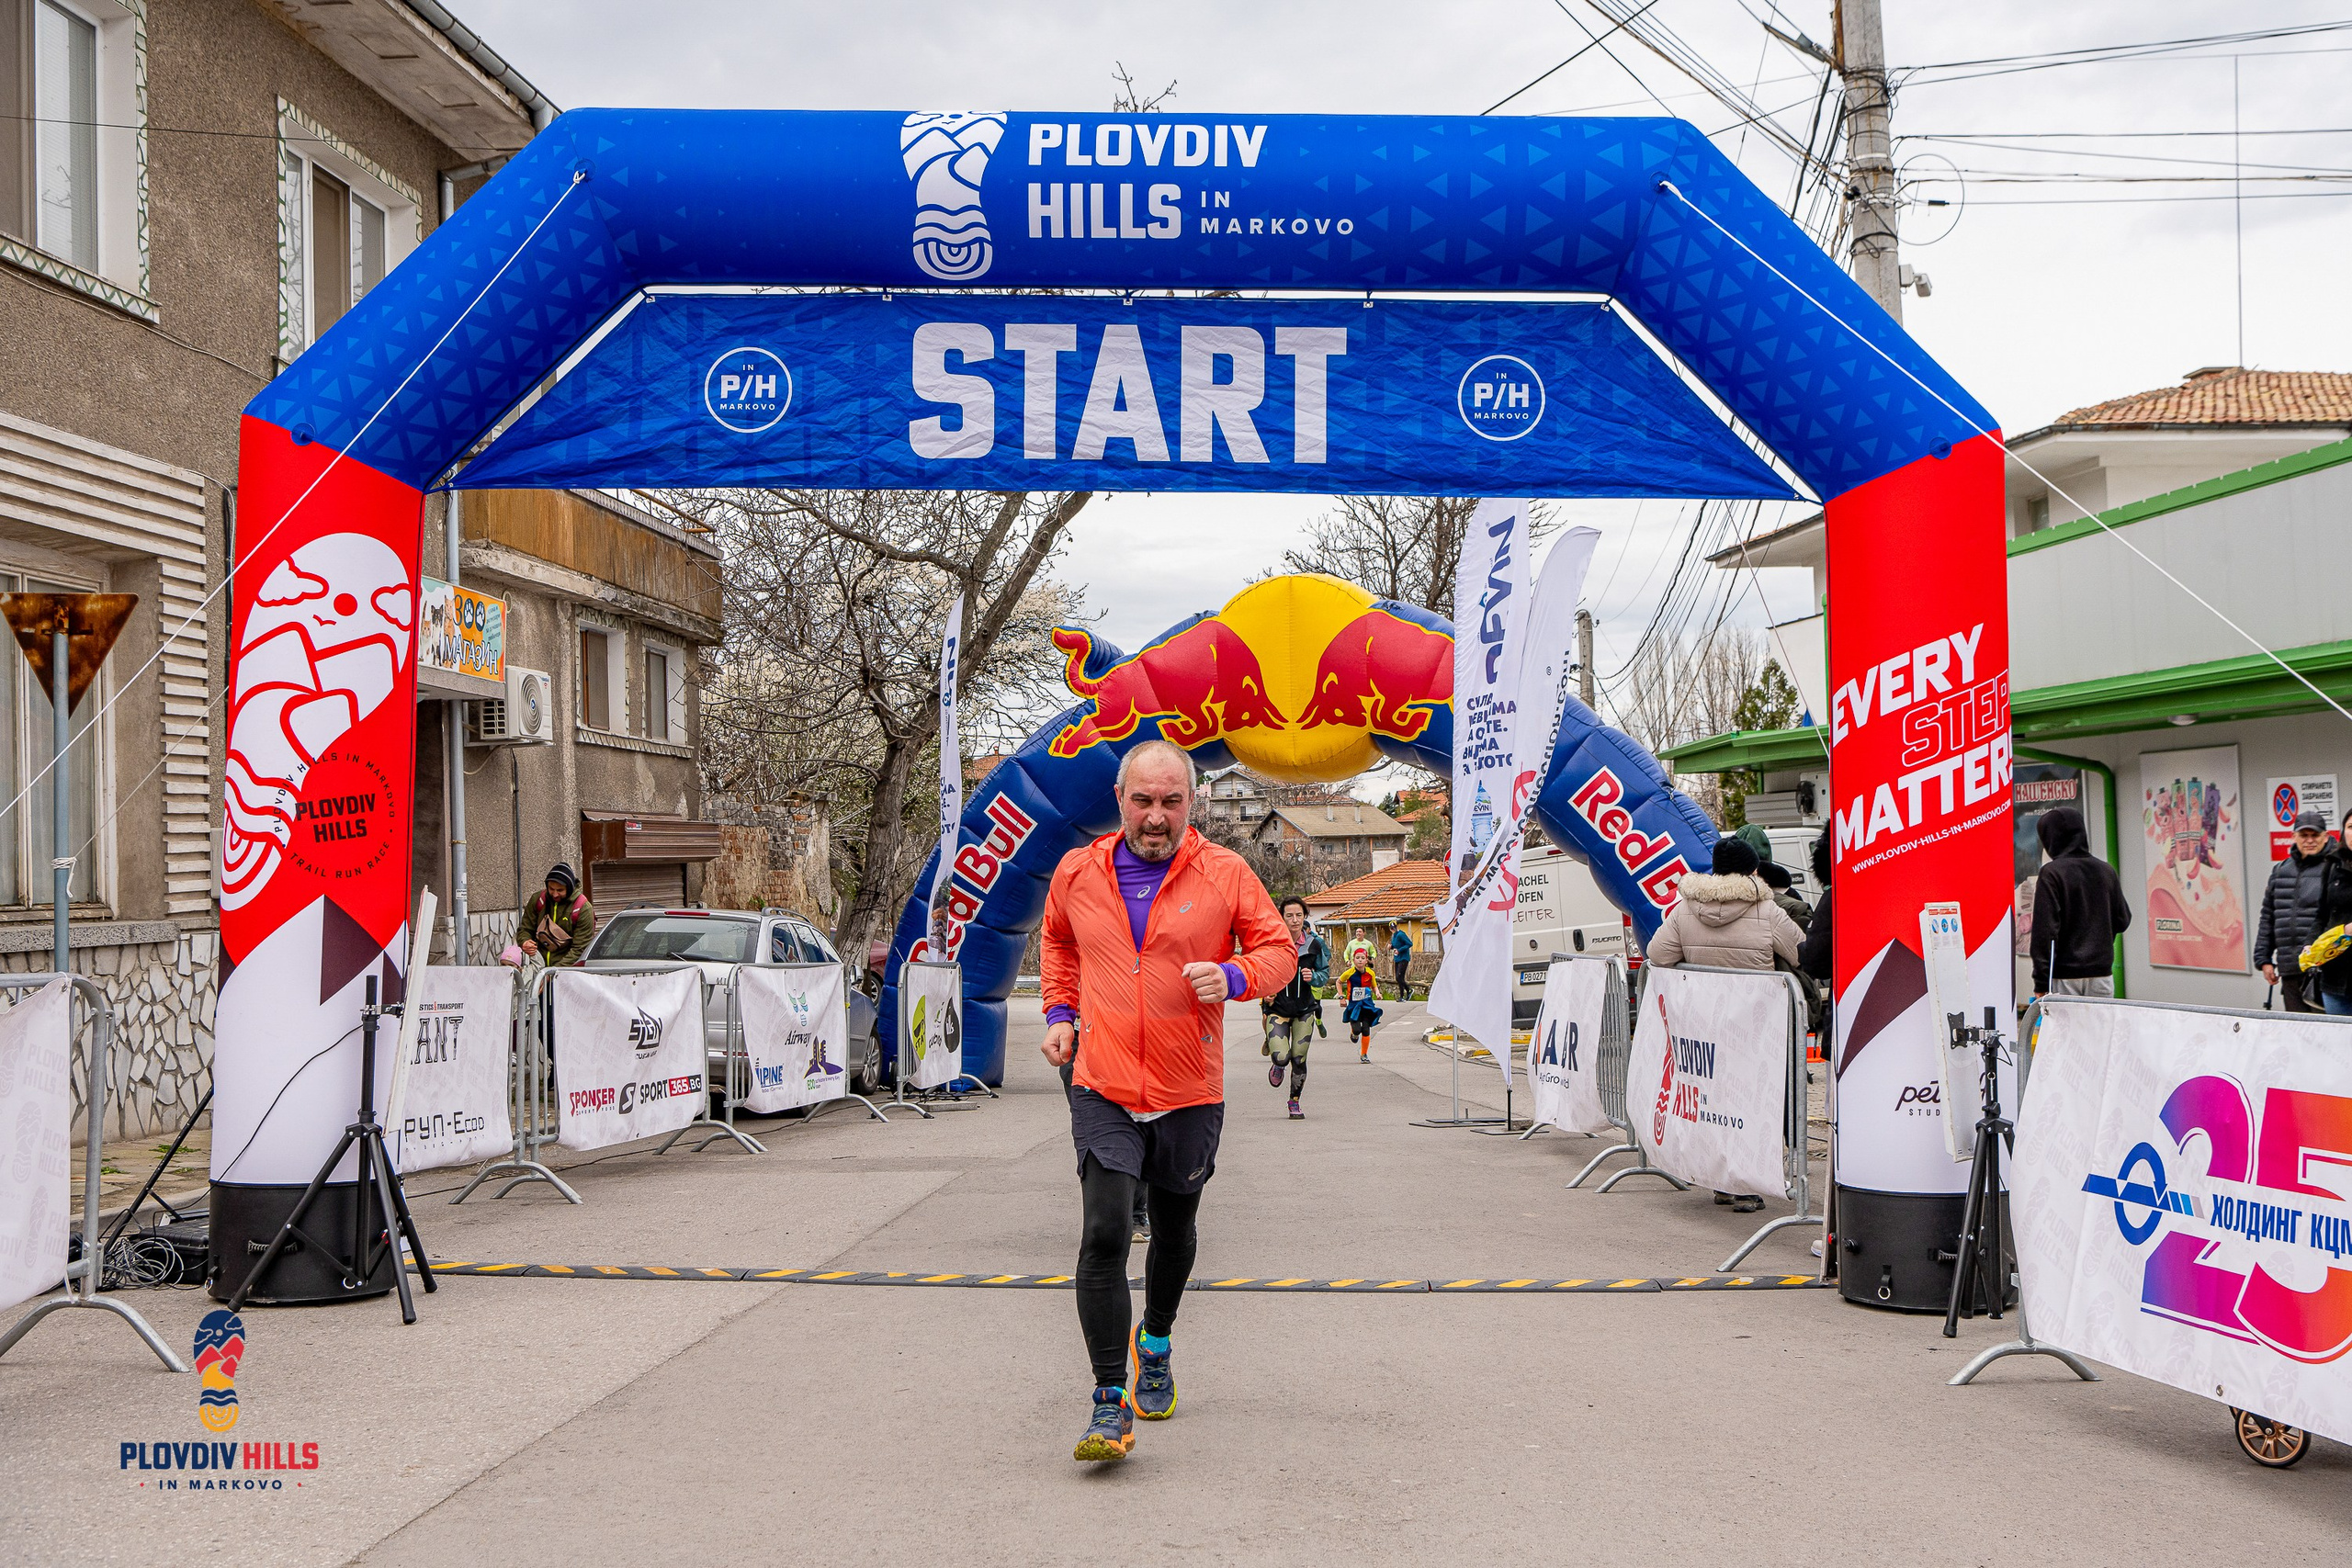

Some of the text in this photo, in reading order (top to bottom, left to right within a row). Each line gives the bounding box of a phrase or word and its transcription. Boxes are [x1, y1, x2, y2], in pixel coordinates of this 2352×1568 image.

[1028, 123, 1268, 167] PLOVDIV
[1028, 183, 1182, 239] HILLS
[1201, 191, 1230, 208] IN
[1201, 218, 1354, 235] MARKOVO
[720, 374, 776, 400] P/H
[909, 321, 1348, 464] START
[1474, 382, 1529, 410] P/H
[444, 634, 499, 675] МАГАЗИН
[1832, 622, 1984, 748] EVERY
[1902, 668, 2010, 768] STEP
[274, 752, 396, 833] PLOVDIV HILLS IN MARKOVO
[295, 793, 376, 821] PLOVDIV
[1836, 726, 2013, 864] MATTER
[313, 818, 368, 843] HILLS
[1569, 767, 1674, 874] Red
[1851, 798, 2012, 874] WWW.PLOVDIV-HILLS-IN-MARKOVO.COM
[289, 840, 390, 878] TRAIL RUN RACE
[953, 793, 1035, 892] Bull
[1518, 874, 1549, 886] ACHEL
[1518, 891, 1544, 903] ÖFEN
[419, 1002, 464, 1011] STICS TRANSPORT
[785, 1030, 812, 1047] Airway
[2210, 1193, 2302, 1244] ХОЛДИНГ
